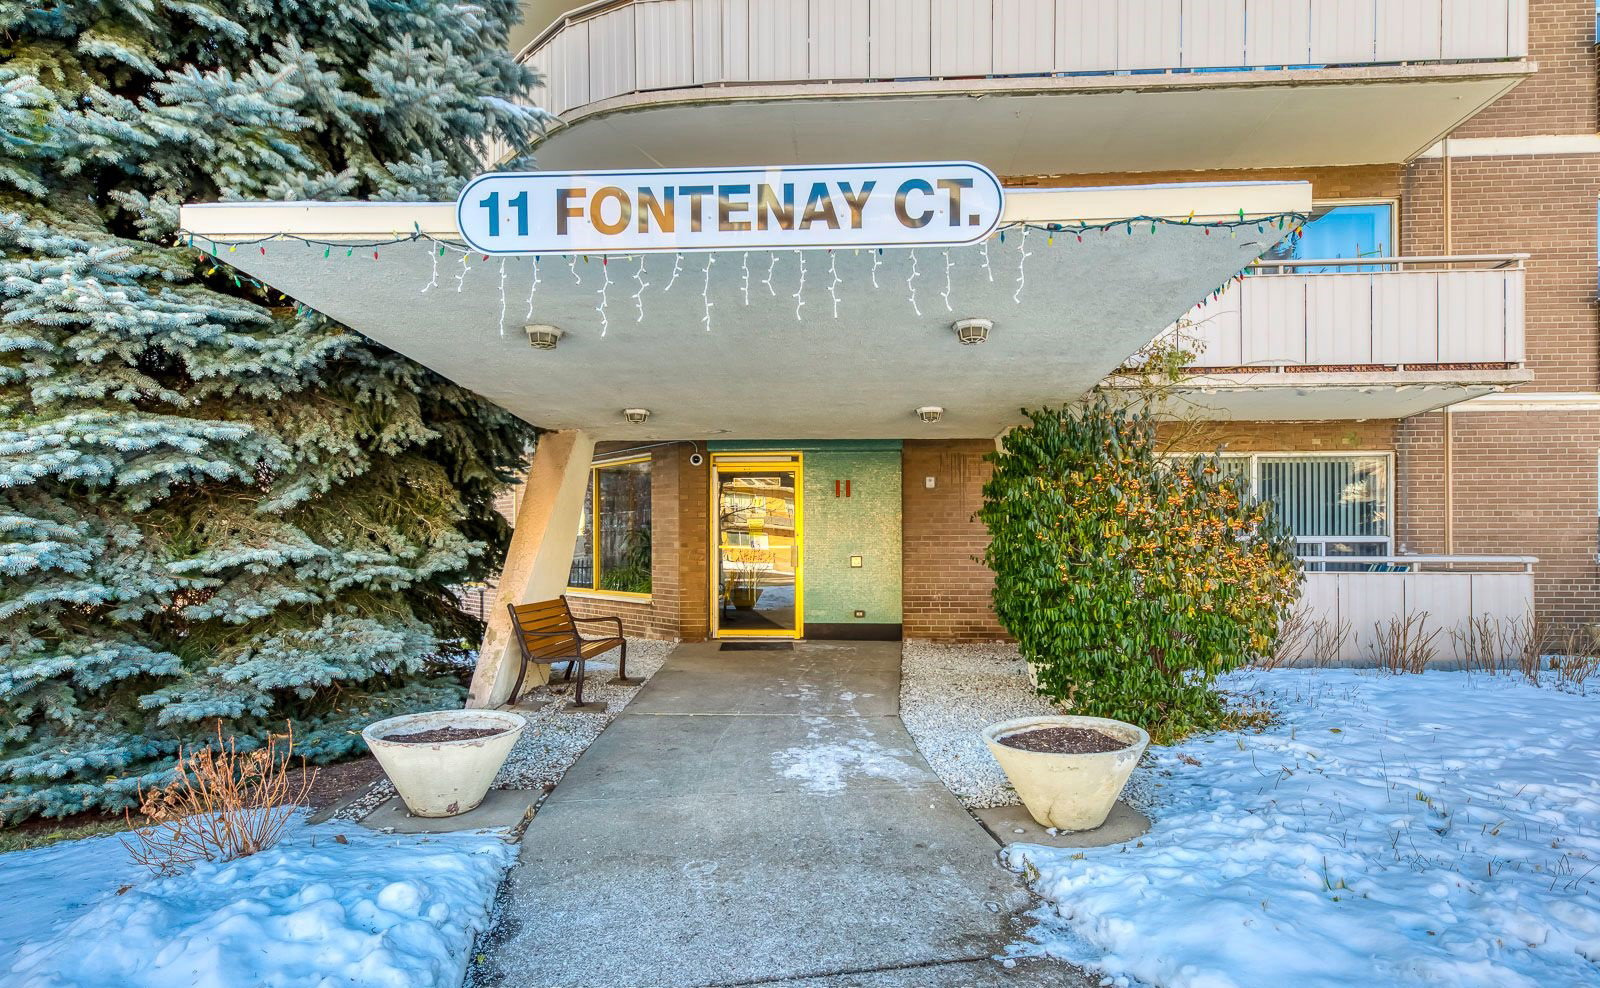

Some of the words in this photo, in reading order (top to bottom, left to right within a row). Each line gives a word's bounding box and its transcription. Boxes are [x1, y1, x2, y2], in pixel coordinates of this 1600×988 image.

[479, 191, 529, 237] 11
[556, 181, 877, 235] FONTENAY
[894, 178, 980, 229] CT.
[835, 479, 851, 498] 11
